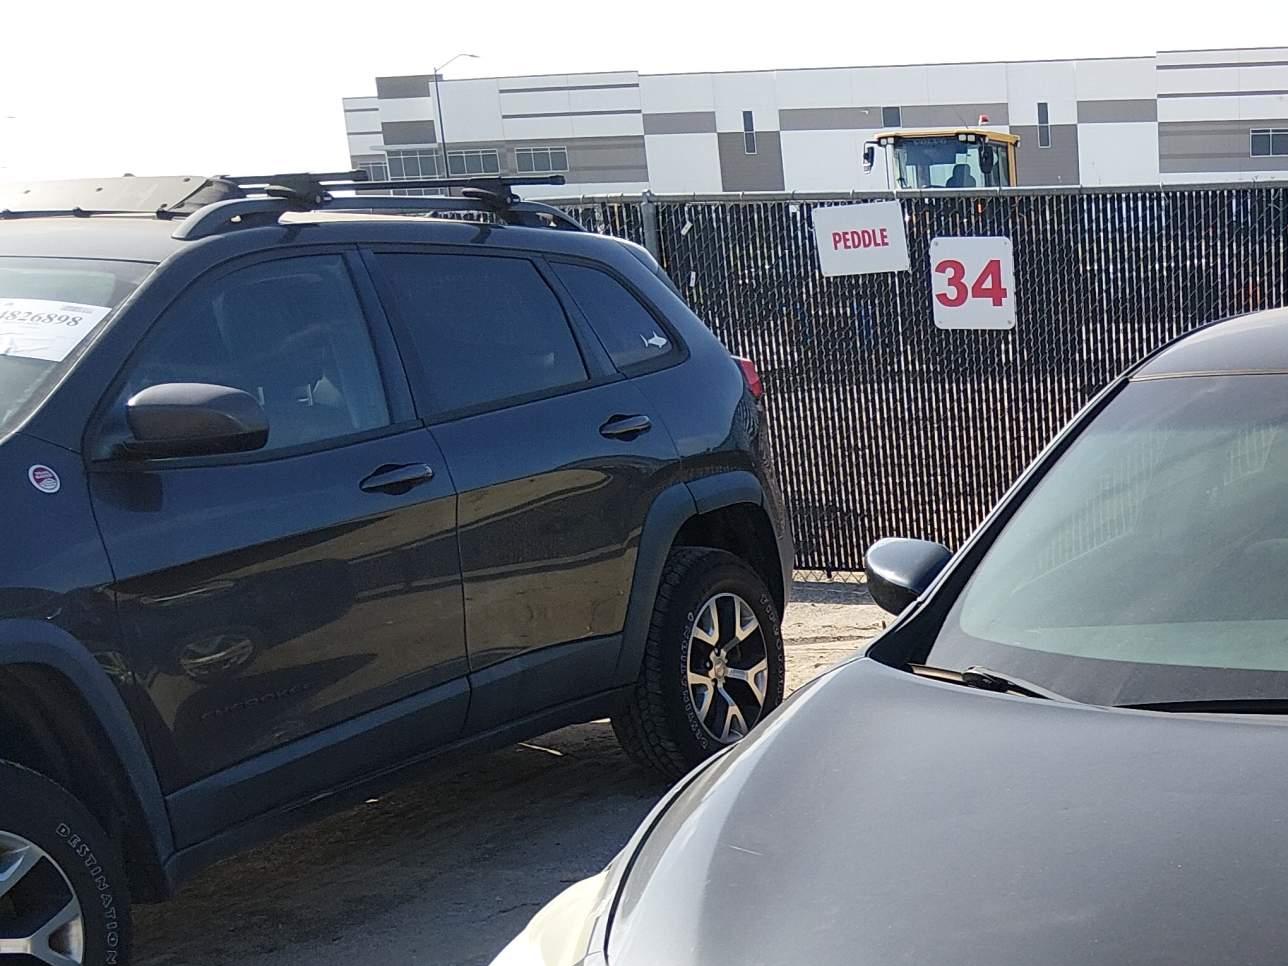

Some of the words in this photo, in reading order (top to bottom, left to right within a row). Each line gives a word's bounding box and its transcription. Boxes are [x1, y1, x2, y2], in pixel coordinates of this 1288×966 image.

[832, 228, 889, 250] PEDDLE
[935, 259, 1007, 308] 34
[55, 822, 119, 965] DESTINATION
